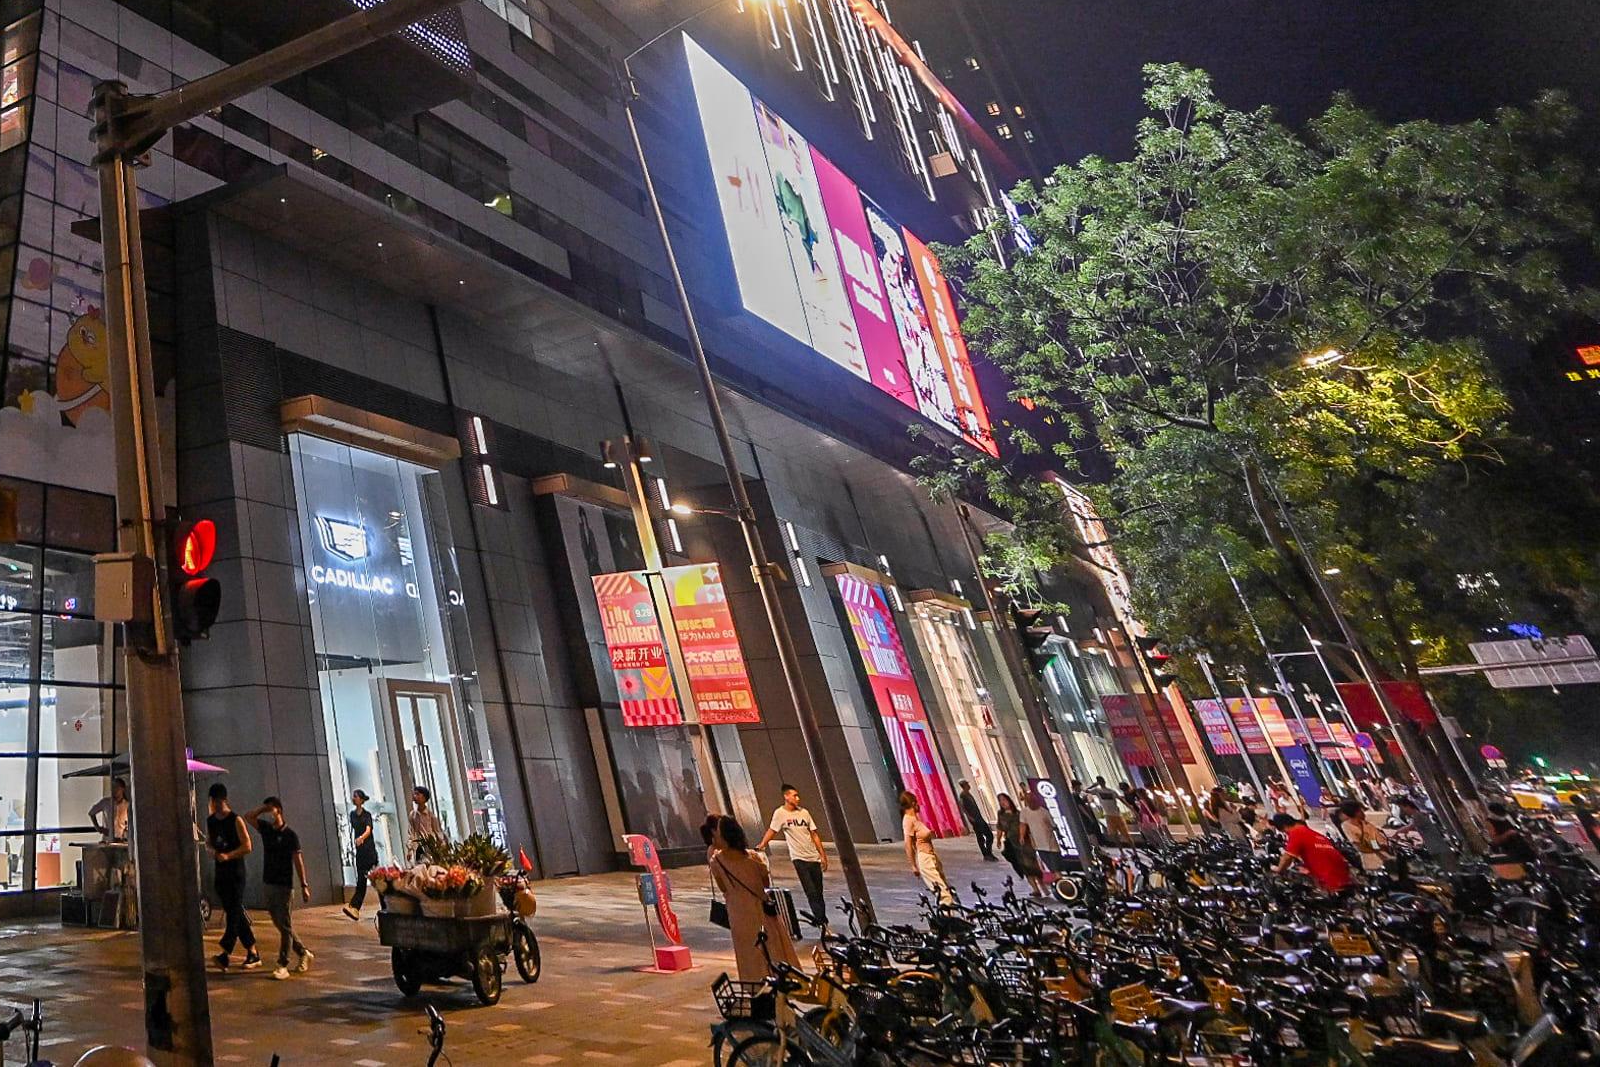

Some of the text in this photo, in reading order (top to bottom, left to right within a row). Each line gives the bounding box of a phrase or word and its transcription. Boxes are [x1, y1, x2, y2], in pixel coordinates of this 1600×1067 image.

[311, 565, 395, 595] CADILLAC
[607, 621, 660, 644] MOMENT
[612, 646, 664, 663] 焕新开业
[787, 818, 809, 827] FILA
